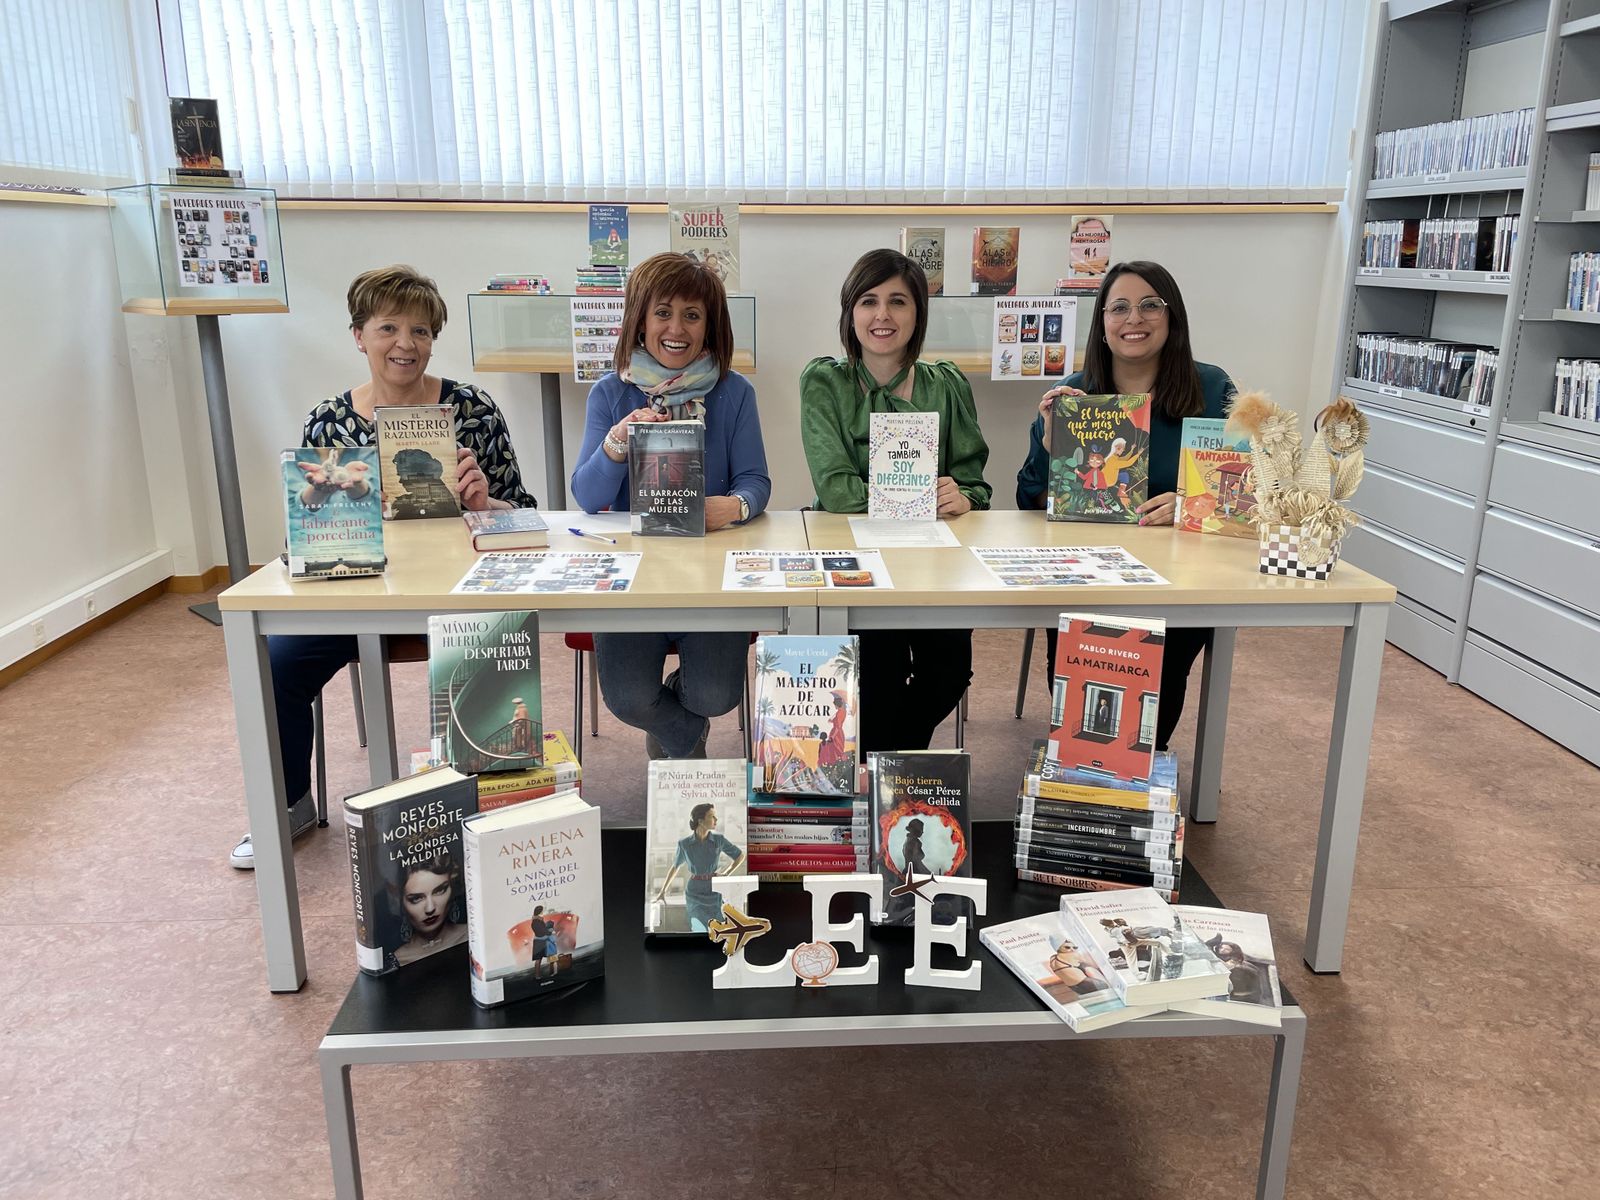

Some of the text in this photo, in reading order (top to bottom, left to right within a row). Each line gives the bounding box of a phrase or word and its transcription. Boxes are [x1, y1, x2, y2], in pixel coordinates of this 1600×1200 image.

[684, 212, 725, 226] SUPER
[682, 226, 728, 238] PODERES
[908, 248, 933, 258] ALAS
[983, 249, 1005, 257] ALAS
[919, 261, 942, 270] NGRE
[1081, 407, 1133, 425] El bosque
[384, 420, 449, 430] MISTERIO
[1068, 418, 1112, 436] que más
[384, 430, 450, 439] RAZUMOVSKI
[1076, 429, 1116, 447] quiero
[898, 440, 909, 450] YO
[1197, 436, 1223, 449] TREN
[1195, 451, 1241, 462] FANTASMA
[893, 461, 915, 474] SOY
[650, 488, 697, 497] BARRACÓN
[302, 516, 370, 529] fabricante
[307, 529, 376, 544] porcelana
[443, 621, 488, 634] MÁXIMO
[442, 635, 482, 647] HUERTA
[502, 630, 531, 644] PARÍS
[464, 645, 532, 660] DESPERTABA
[1079, 644, 1140, 660] PABLO RIVERO
[497, 658, 531, 671] TARDE
[800, 663, 813, 674] EL
[1066, 656, 1150, 677] LA MATRIARCA
[776, 676, 836, 688] MAESTRO
[798, 691, 814, 702] DE
[780, 702, 831, 716] AZÚCAR
[668, 771, 726, 780] Núria Pradas
[895, 775, 943, 786] Bajo tierra
[658, 781, 670, 790] La
[672, 780, 690, 789] vida
[907, 786, 933, 795] César
[936, 786, 961, 796] Pérez
[681, 789, 736, 799] Sylvia Nolan
[928, 796, 960, 806] Gellida
[400, 801, 444, 824] REYES
[383, 808, 463, 844] MONFORTE
[1067, 824, 1116, 836] INCERTIDUMBRE
[390, 832, 459, 861] LA CONDESA
[499, 828, 584, 856] ANA LENA
[402, 846, 449, 868] MALDITA
[512, 846, 572, 870] RIVERA
[348, 827, 364, 922] REYES MONFORTE
[506, 862, 579, 886] LA NIÑA DEL
[511, 874, 576, 896] SOMBRERO
[1060, 876, 1097, 890] SOBRES
[528, 889, 560, 902] AZUL
[712, 874, 988, 990] LEE
